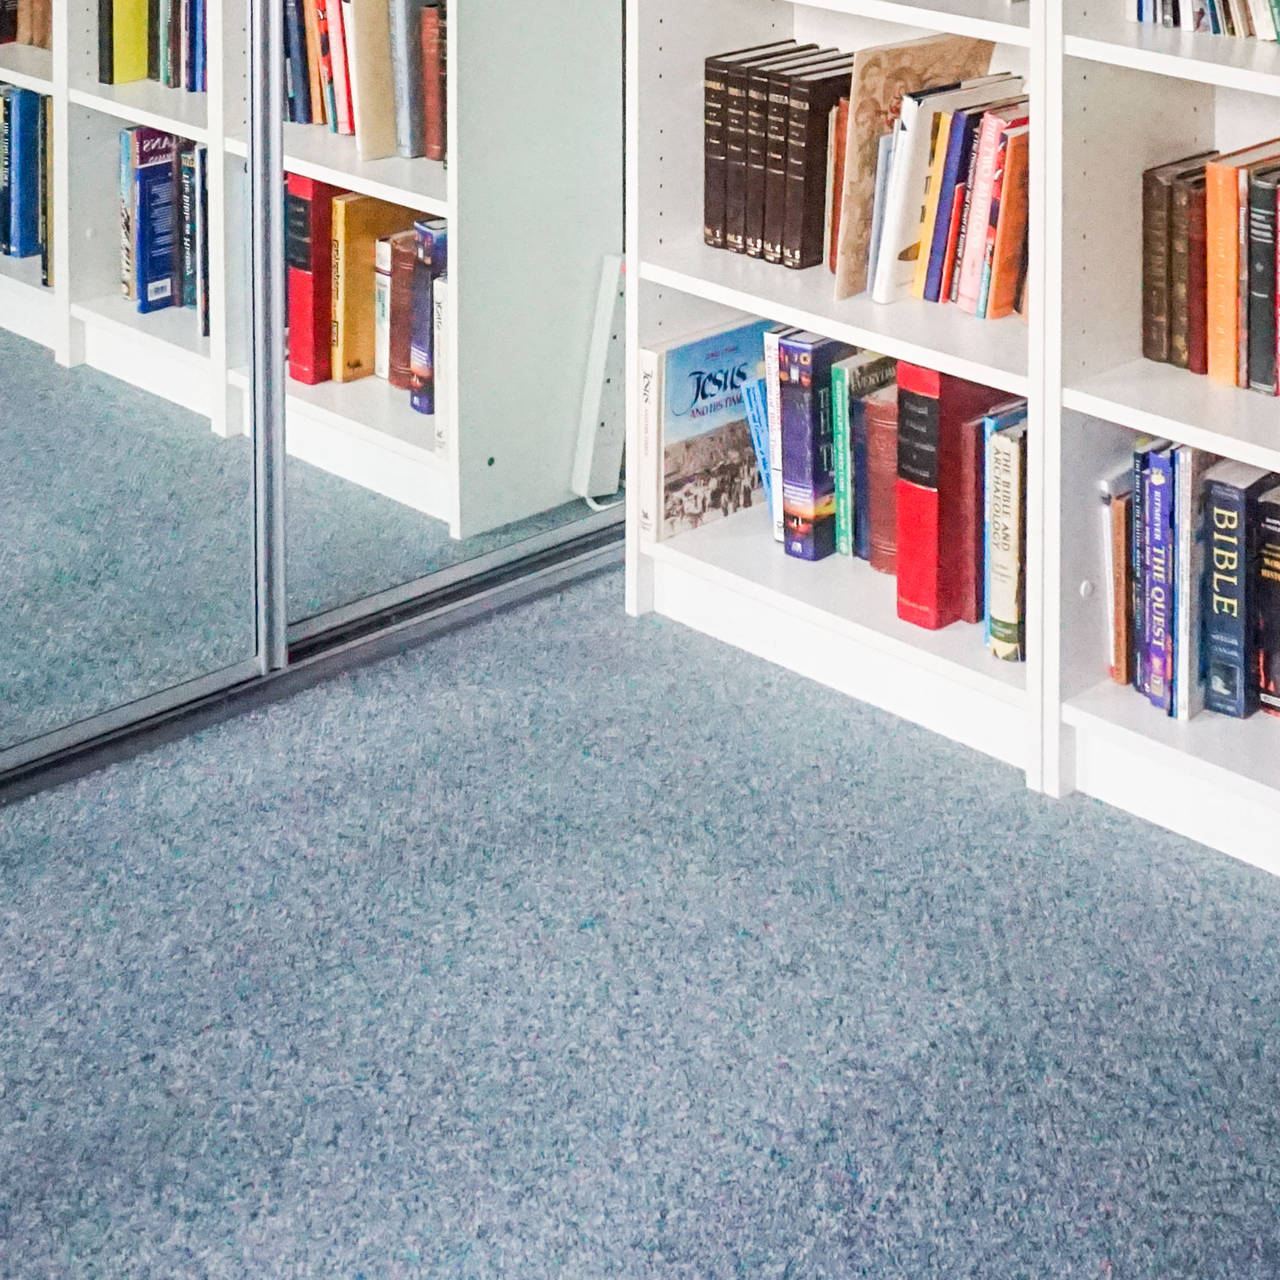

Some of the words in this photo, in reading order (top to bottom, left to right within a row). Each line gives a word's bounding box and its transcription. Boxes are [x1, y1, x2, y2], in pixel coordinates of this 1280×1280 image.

[672, 363, 749, 417] JESUS
[1002, 451, 1011, 473] THE
[992, 447, 1002, 551] ARCHAEOLOGY
[1002, 479, 1012, 520] BIBLE
[1002, 524, 1011, 552] AND
[1213, 506, 1238, 617] BIBLE
[1152, 545, 1166, 582] THE
[1151, 586, 1166, 651] QUEST
